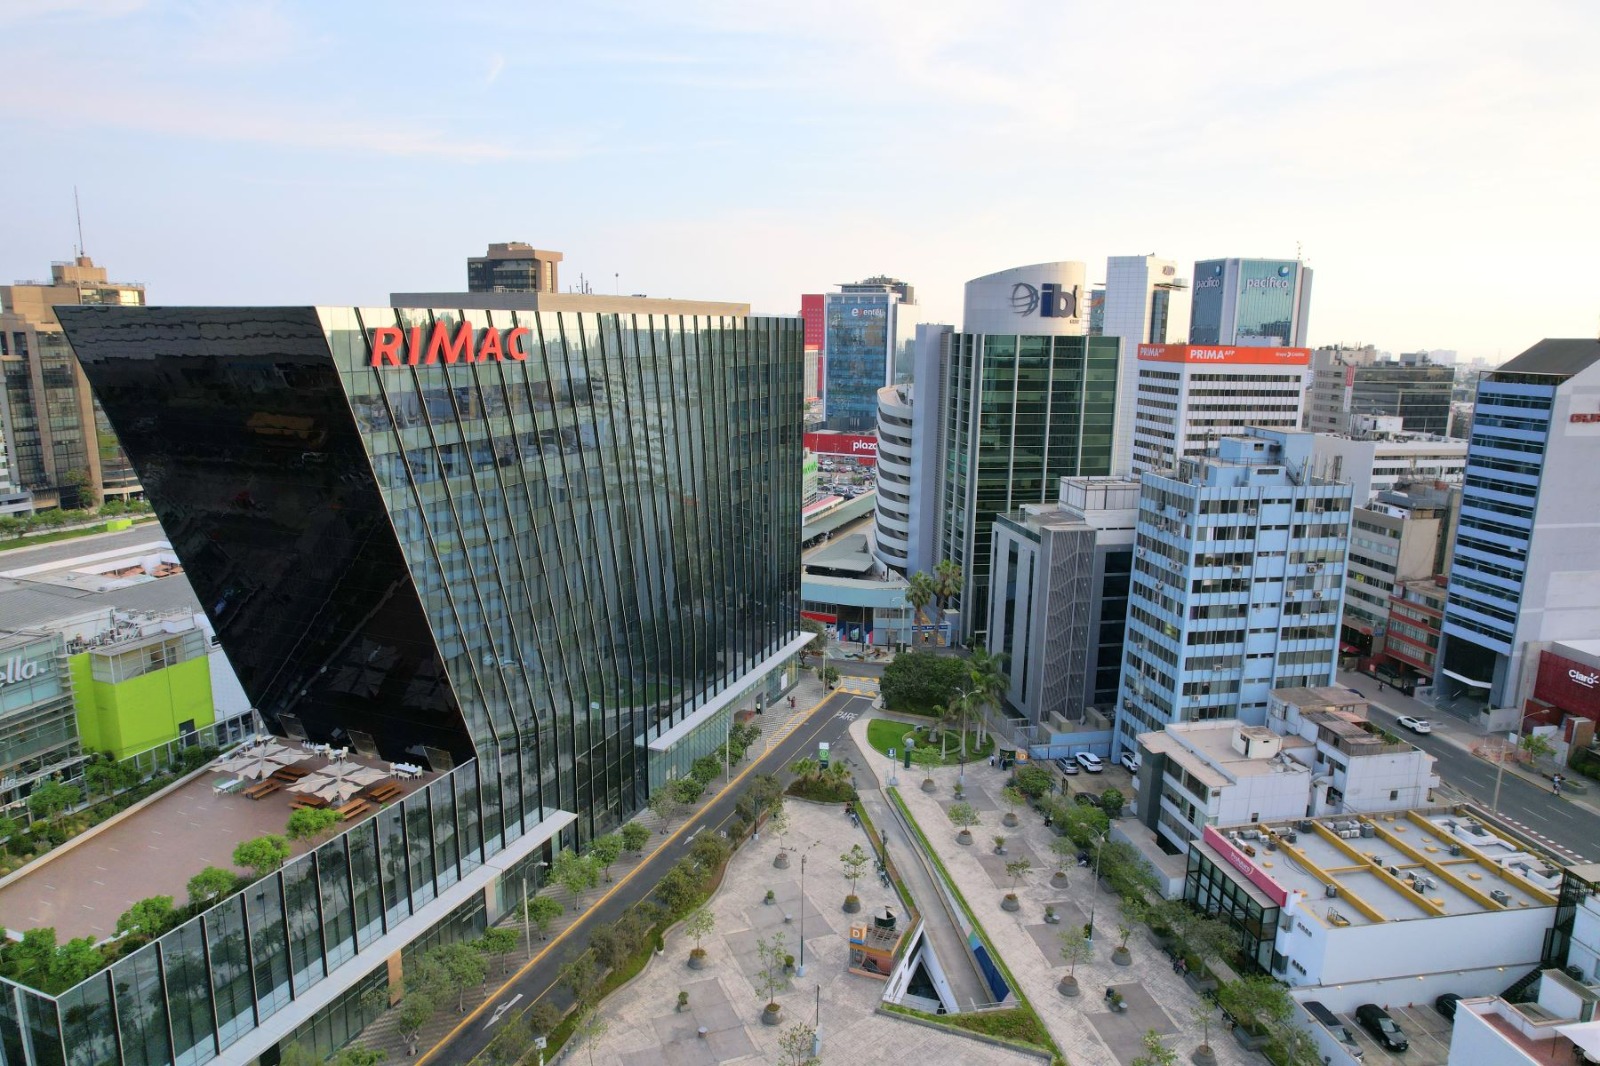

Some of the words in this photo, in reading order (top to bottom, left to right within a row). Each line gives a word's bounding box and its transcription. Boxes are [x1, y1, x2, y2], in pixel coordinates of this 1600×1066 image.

[371, 321, 529, 366] RIMAC
[1140, 347, 1159, 357] PRIMA
[1190, 349, 1224, 360] PRIMA
[1568, 669, 1594, 684] Claro
[834, 711, 859, 722] PARE
[853, 929, 860, 938] D
